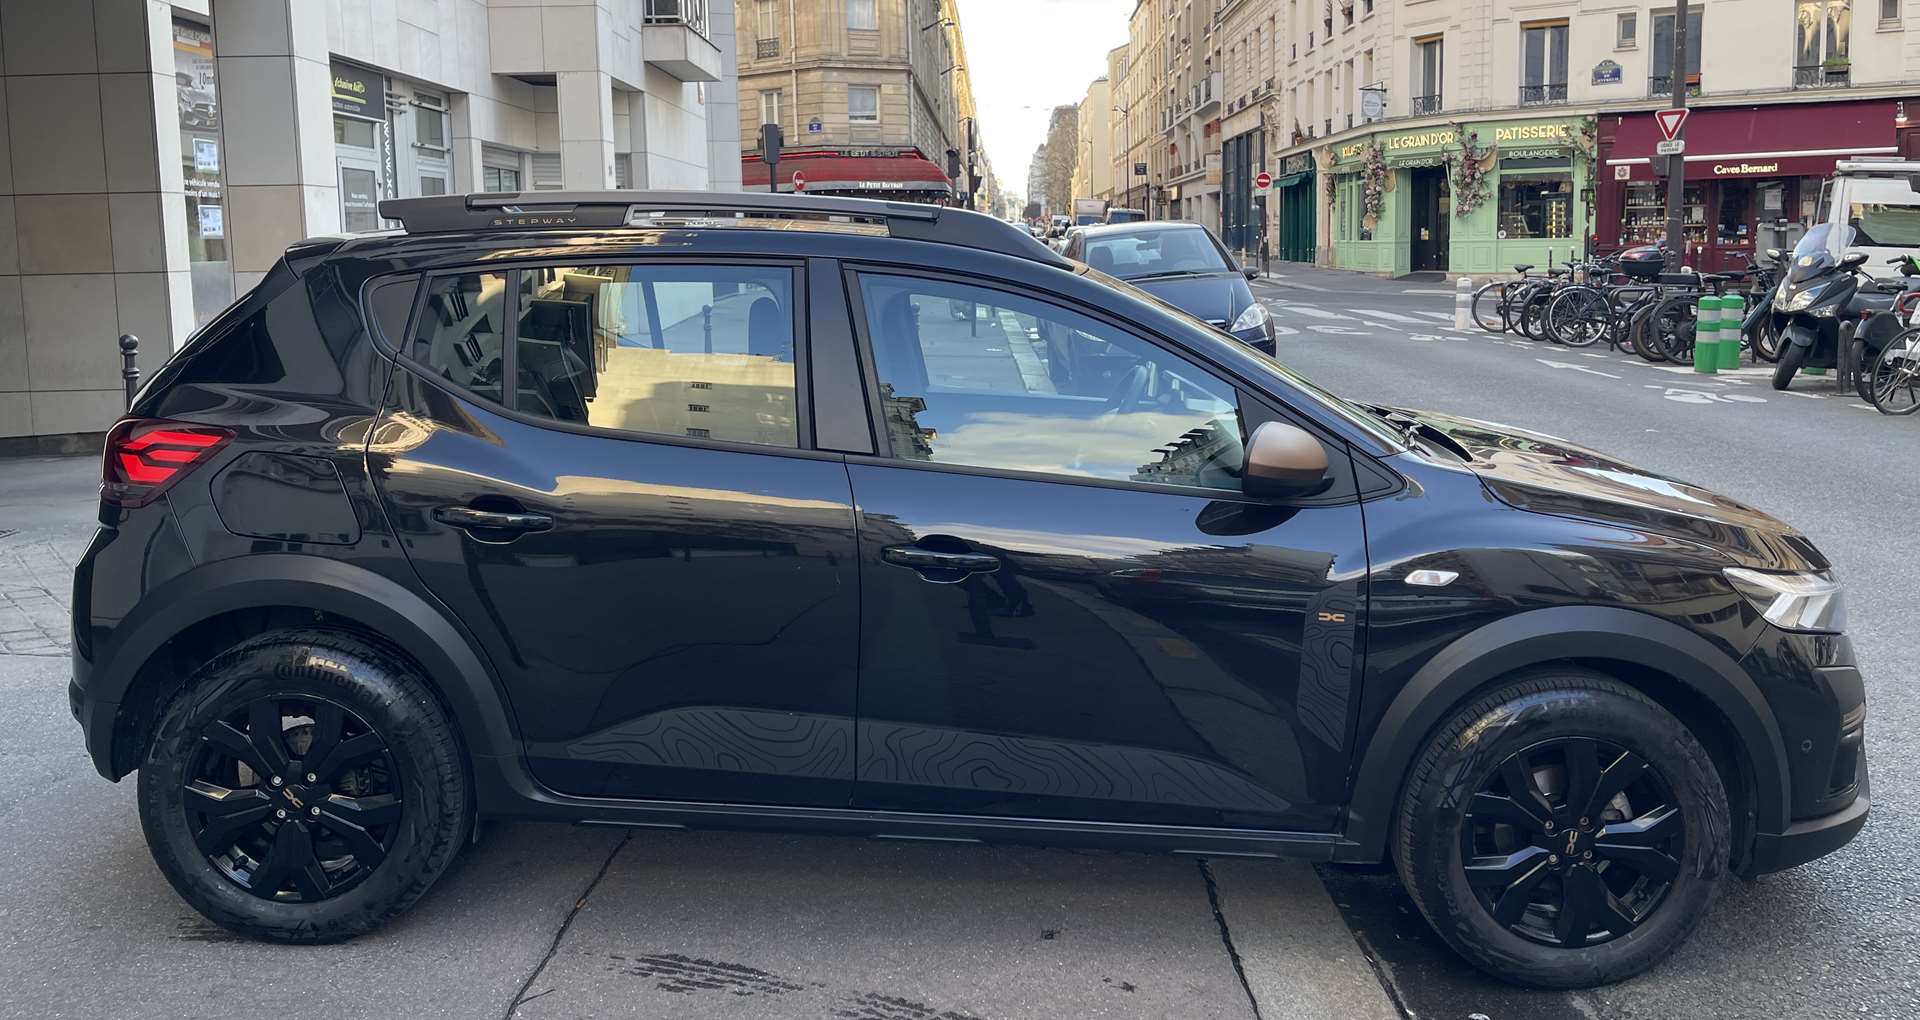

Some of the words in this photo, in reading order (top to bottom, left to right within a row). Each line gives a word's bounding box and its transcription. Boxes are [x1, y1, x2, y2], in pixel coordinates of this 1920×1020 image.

[1496, 125, 1567, 140] PATISSERIE
[1389, 138, 1400, 149] LE
[1401, 134, 1430, 148] GRAIN
[1431, 132, 1454, 146] D'OR
[1509, 149, 1560, 157] BOULANGERIE
[1713, 164, 1740, 175] Caves
[1741, 163, 1778, 174] Bernard
